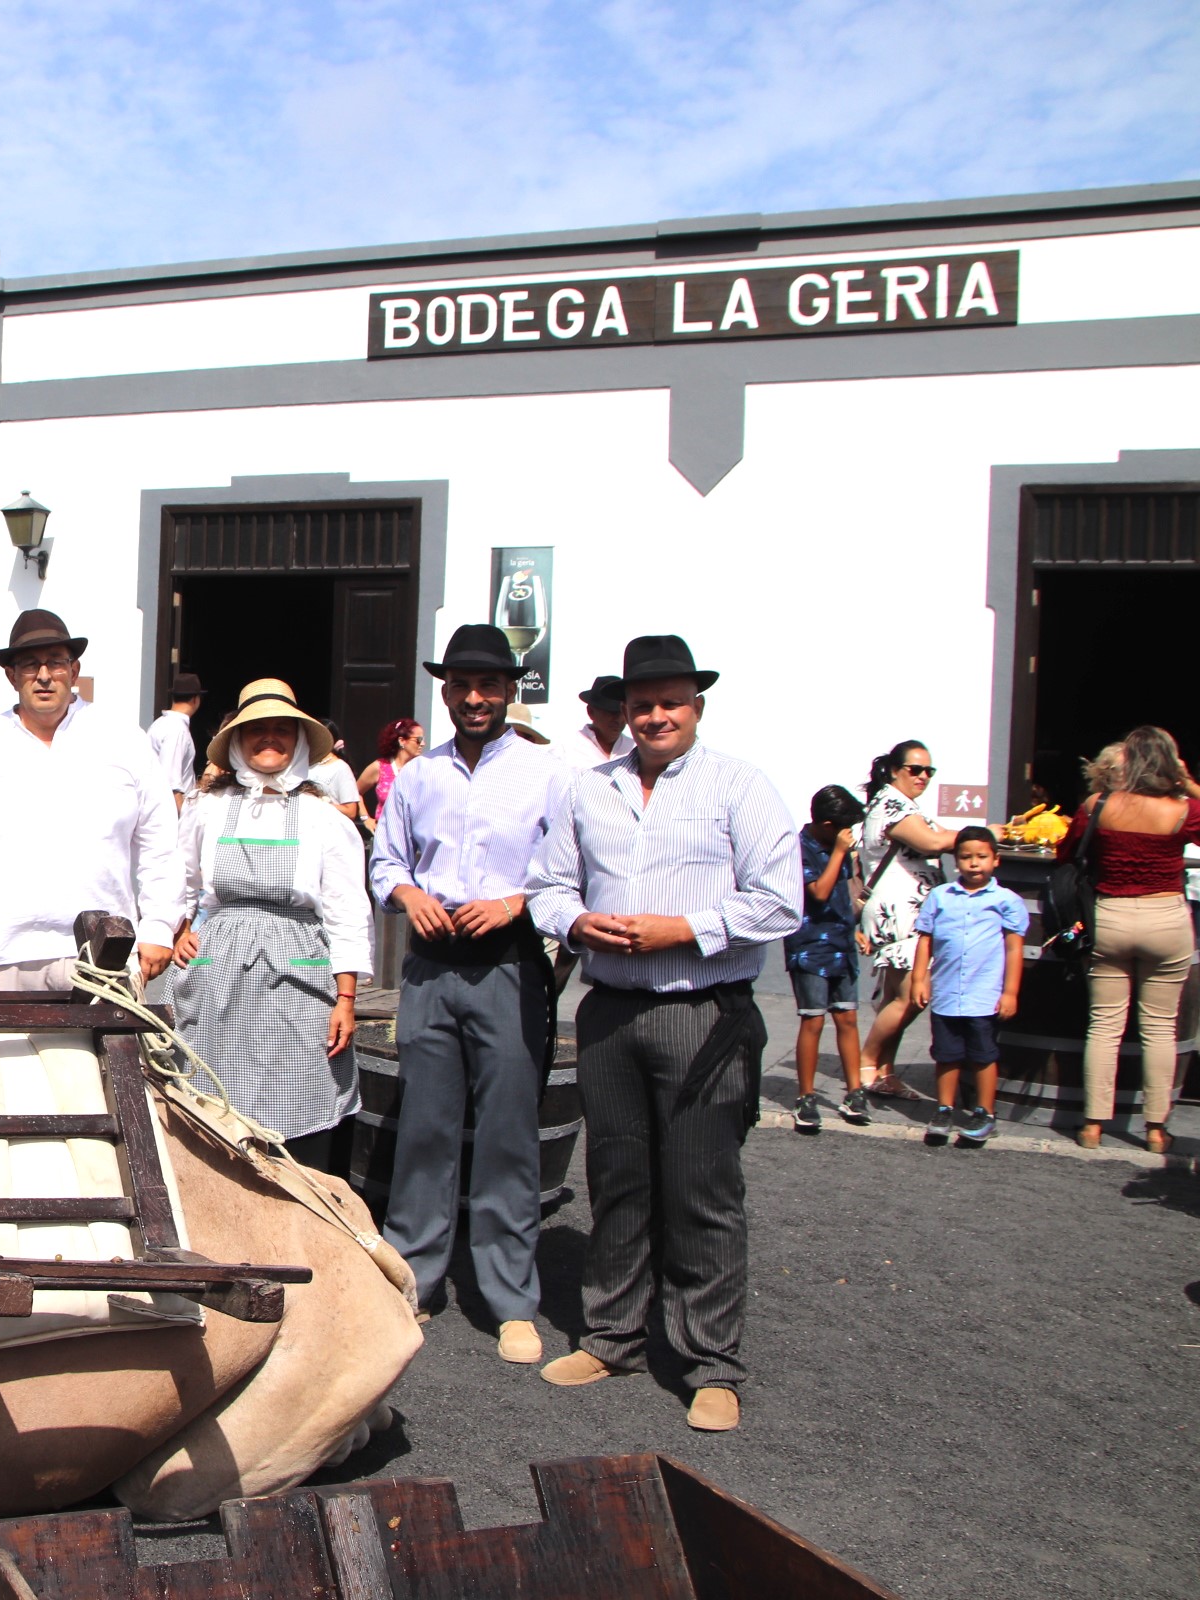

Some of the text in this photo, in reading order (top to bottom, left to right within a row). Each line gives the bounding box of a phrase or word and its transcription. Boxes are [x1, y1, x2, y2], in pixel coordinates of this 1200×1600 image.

[380, 262, 999, 349] BODEGA LA GERIA
